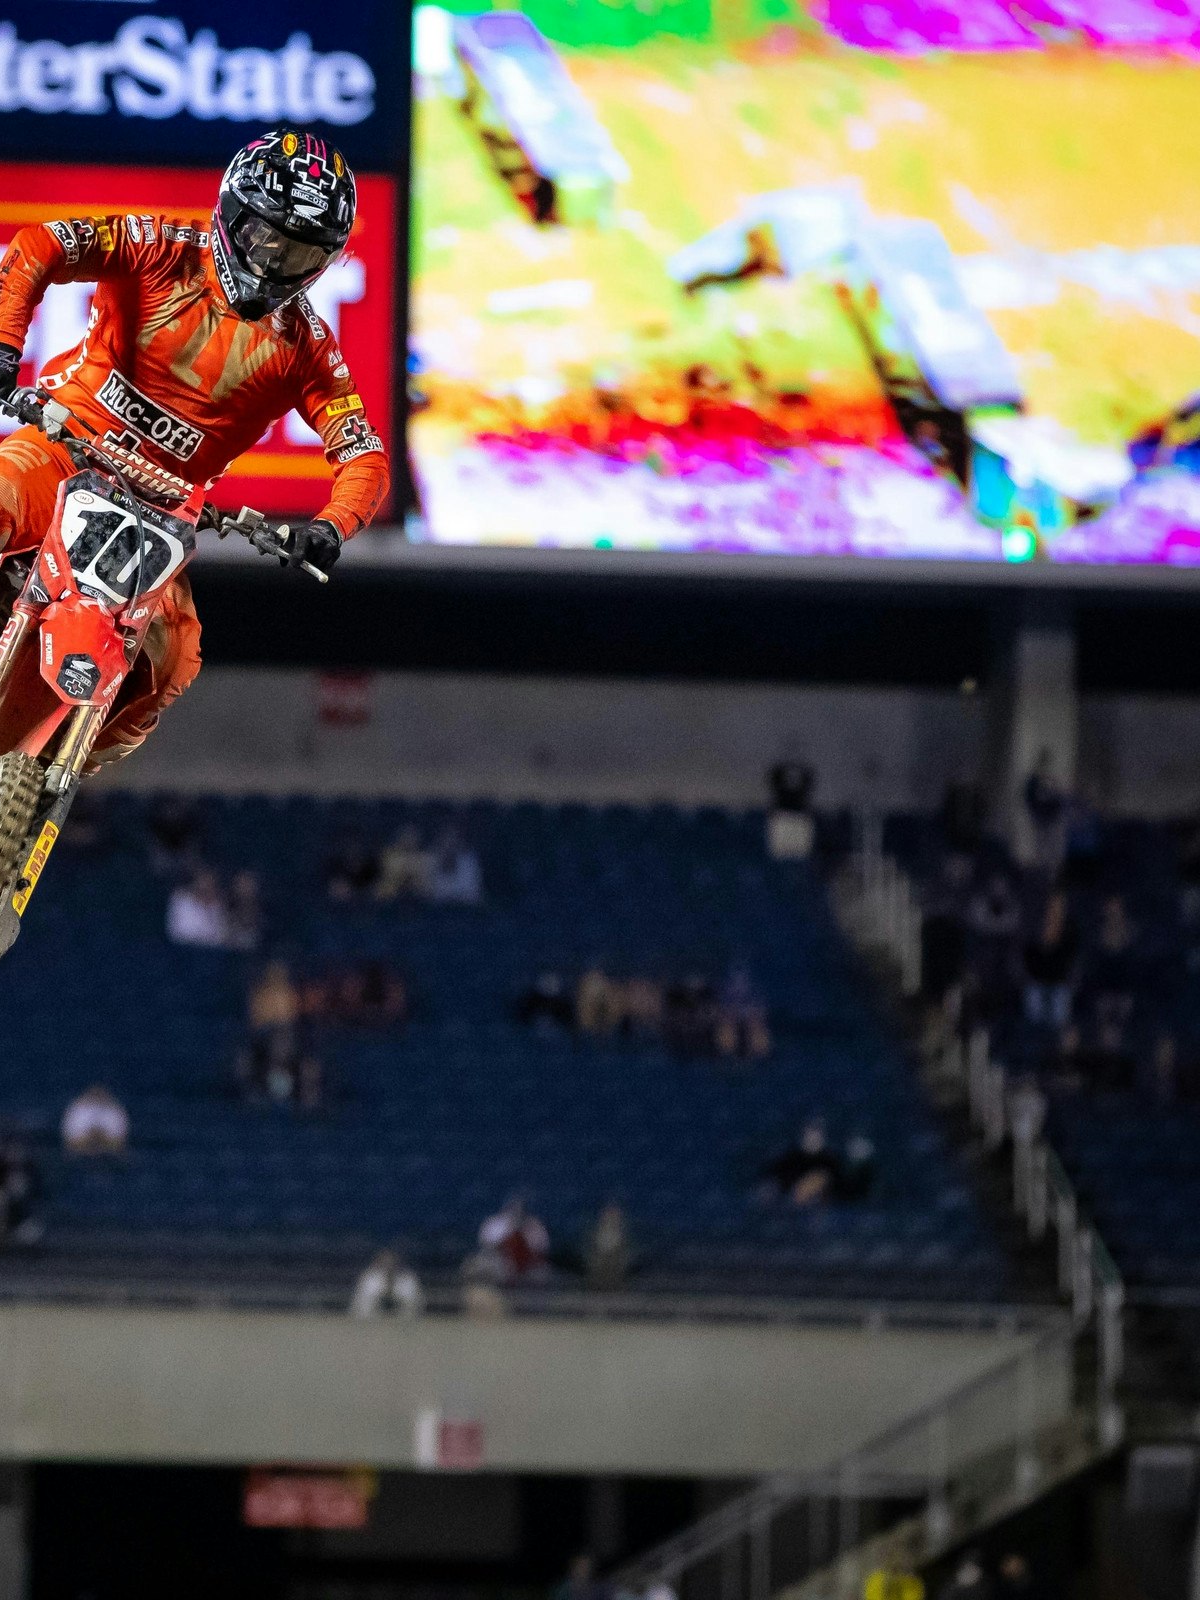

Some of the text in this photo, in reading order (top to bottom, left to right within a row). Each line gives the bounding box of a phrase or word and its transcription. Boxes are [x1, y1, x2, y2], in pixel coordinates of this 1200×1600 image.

[102, 376, 199, 458] Muc-Off
[100, 440, 196, 492] RENTHAL
[67, 510, 173, 594] 10
